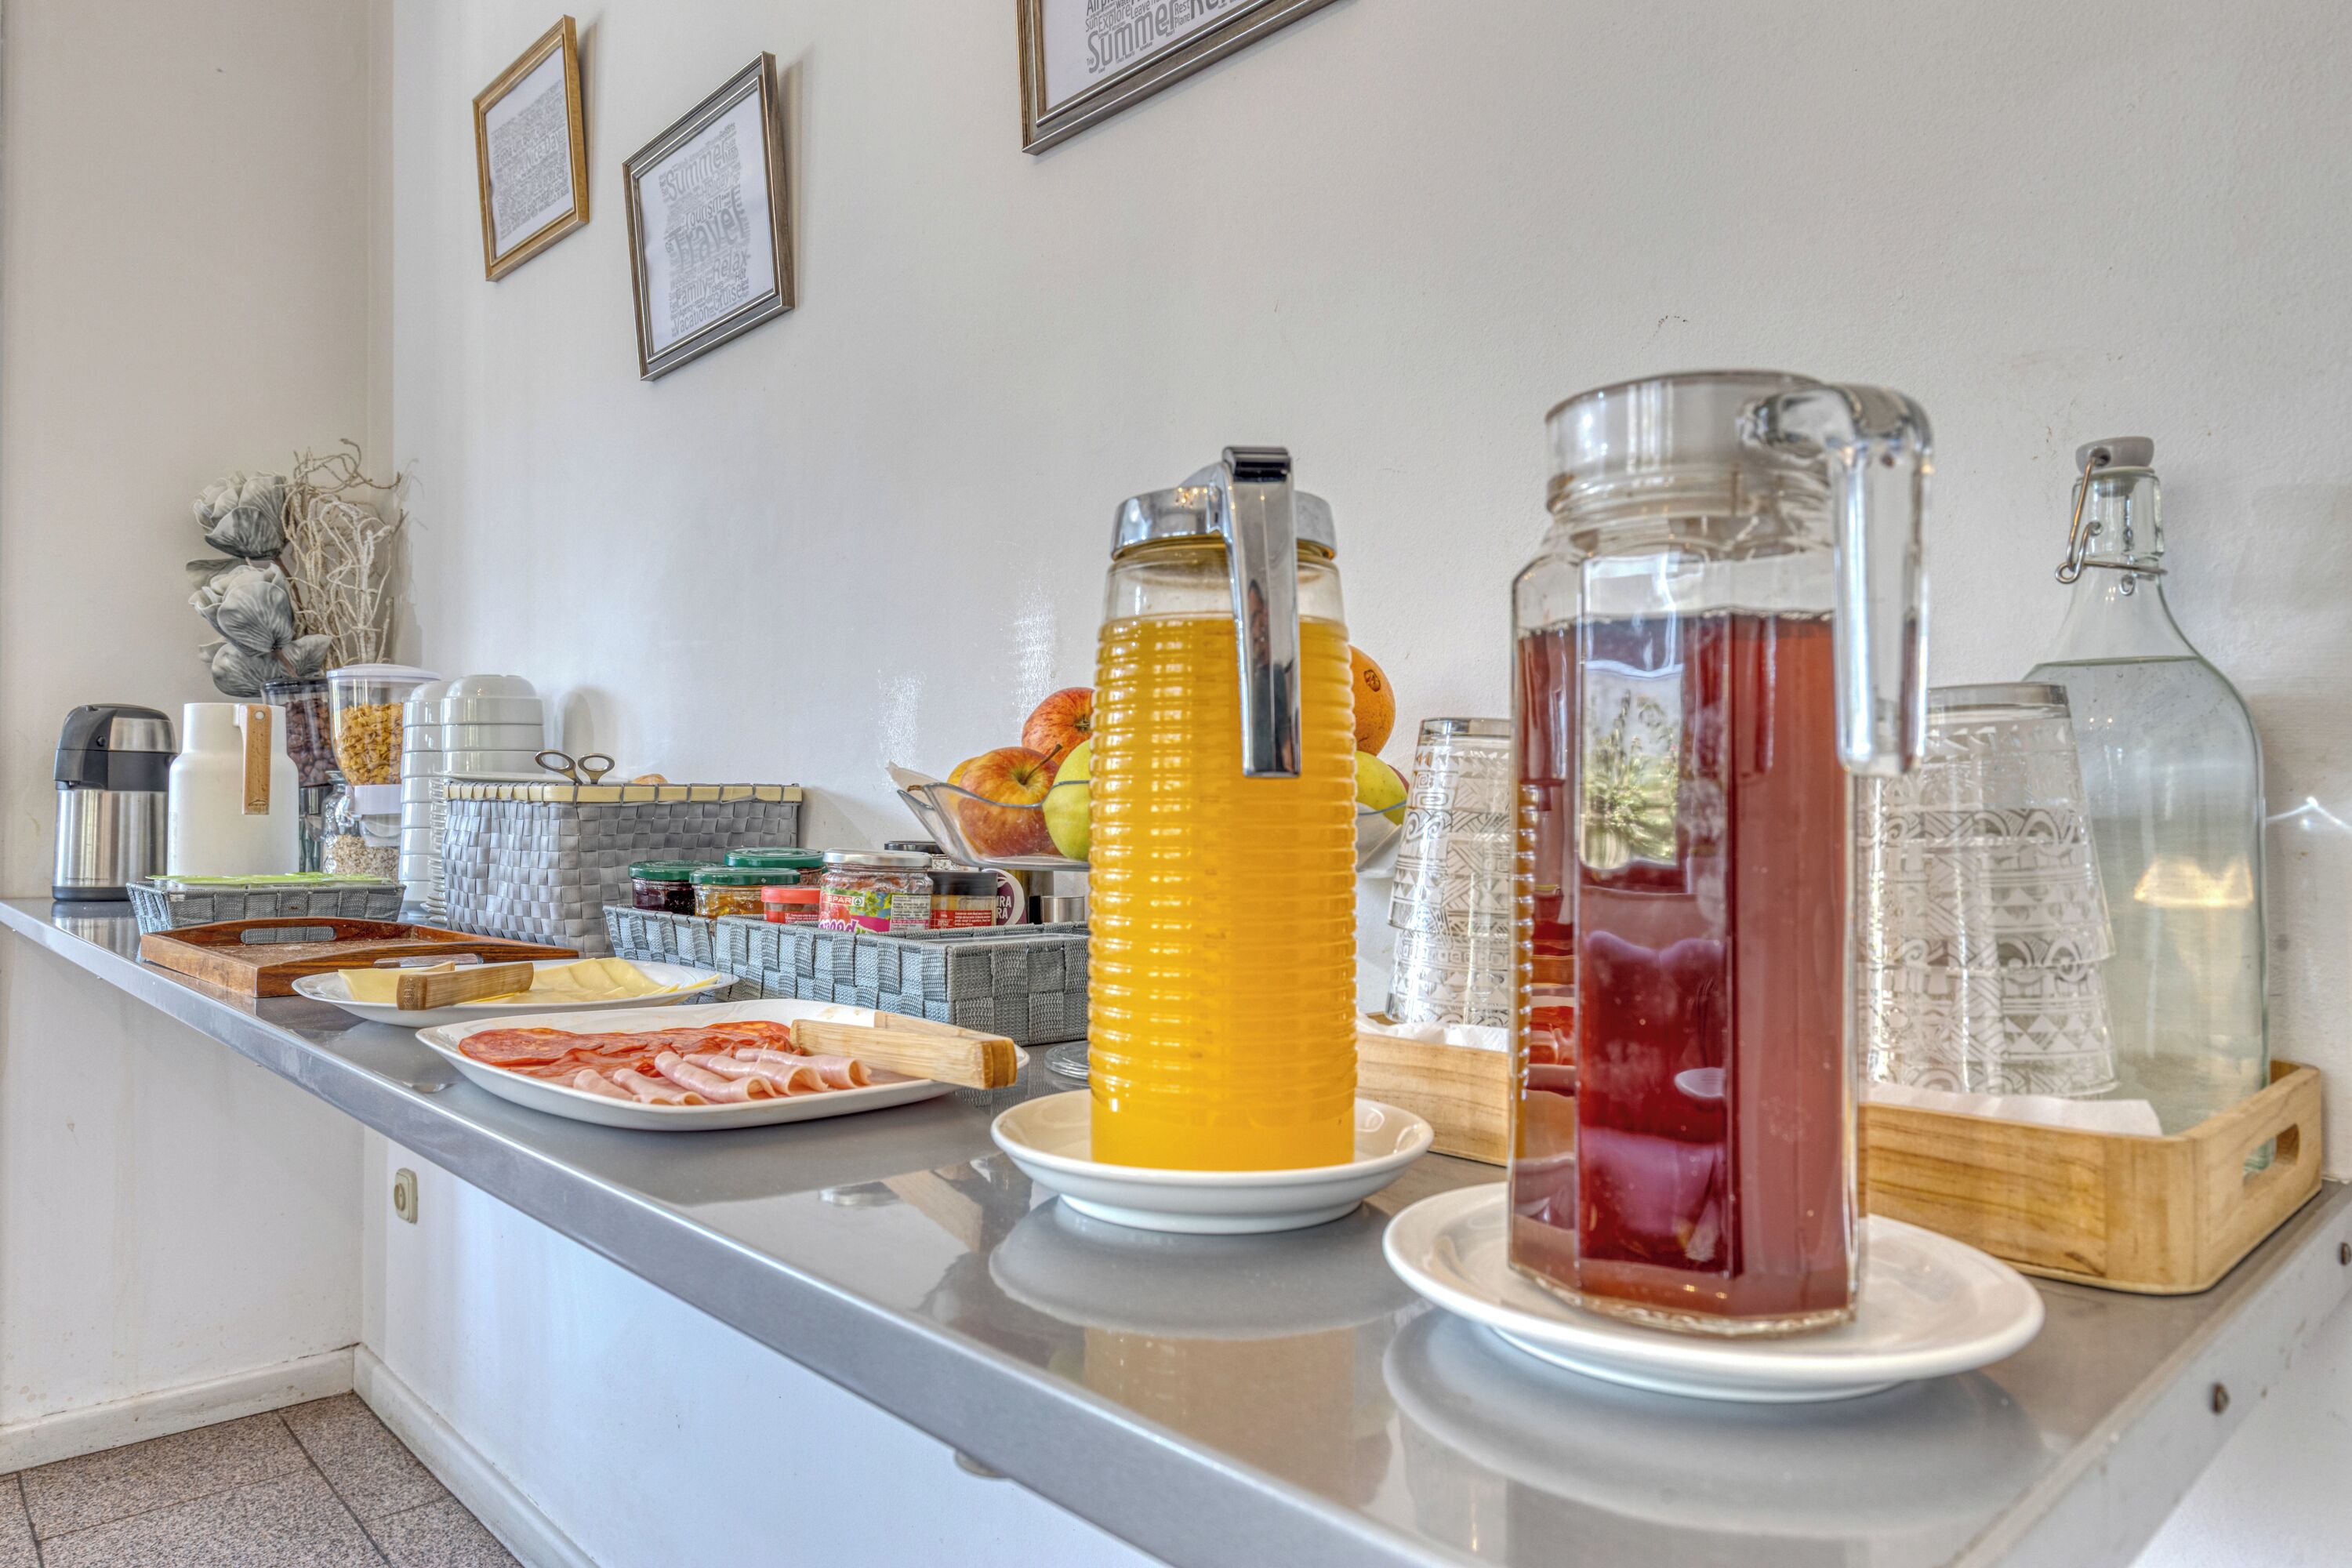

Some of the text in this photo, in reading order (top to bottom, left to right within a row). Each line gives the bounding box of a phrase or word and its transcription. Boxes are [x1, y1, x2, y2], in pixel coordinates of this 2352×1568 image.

[1098, 4, 1131, 32] Explore
[1131, 0, 1150, 19] Leave
[1174, 1, 1190, 16] Rest
[1174, 13, 1191, 28] Plane
[1085, 16, 1098, 32] Sun
[1087, 0, 1176, 74] Summer
[666, 140, 728, 201] Summer
[701, 169, 730, 198] Holiday
[685, 194, 721, 230] Tourism
[667, 188, 745, 273] Travel
[713, 249, 748, 283] Relax
[675, 278, 708, 307] Family
[713, 282, 742, 311] Cruise
[674, 304, 710, 336] Vacation
[827, 895, 851, 905] SPAR
